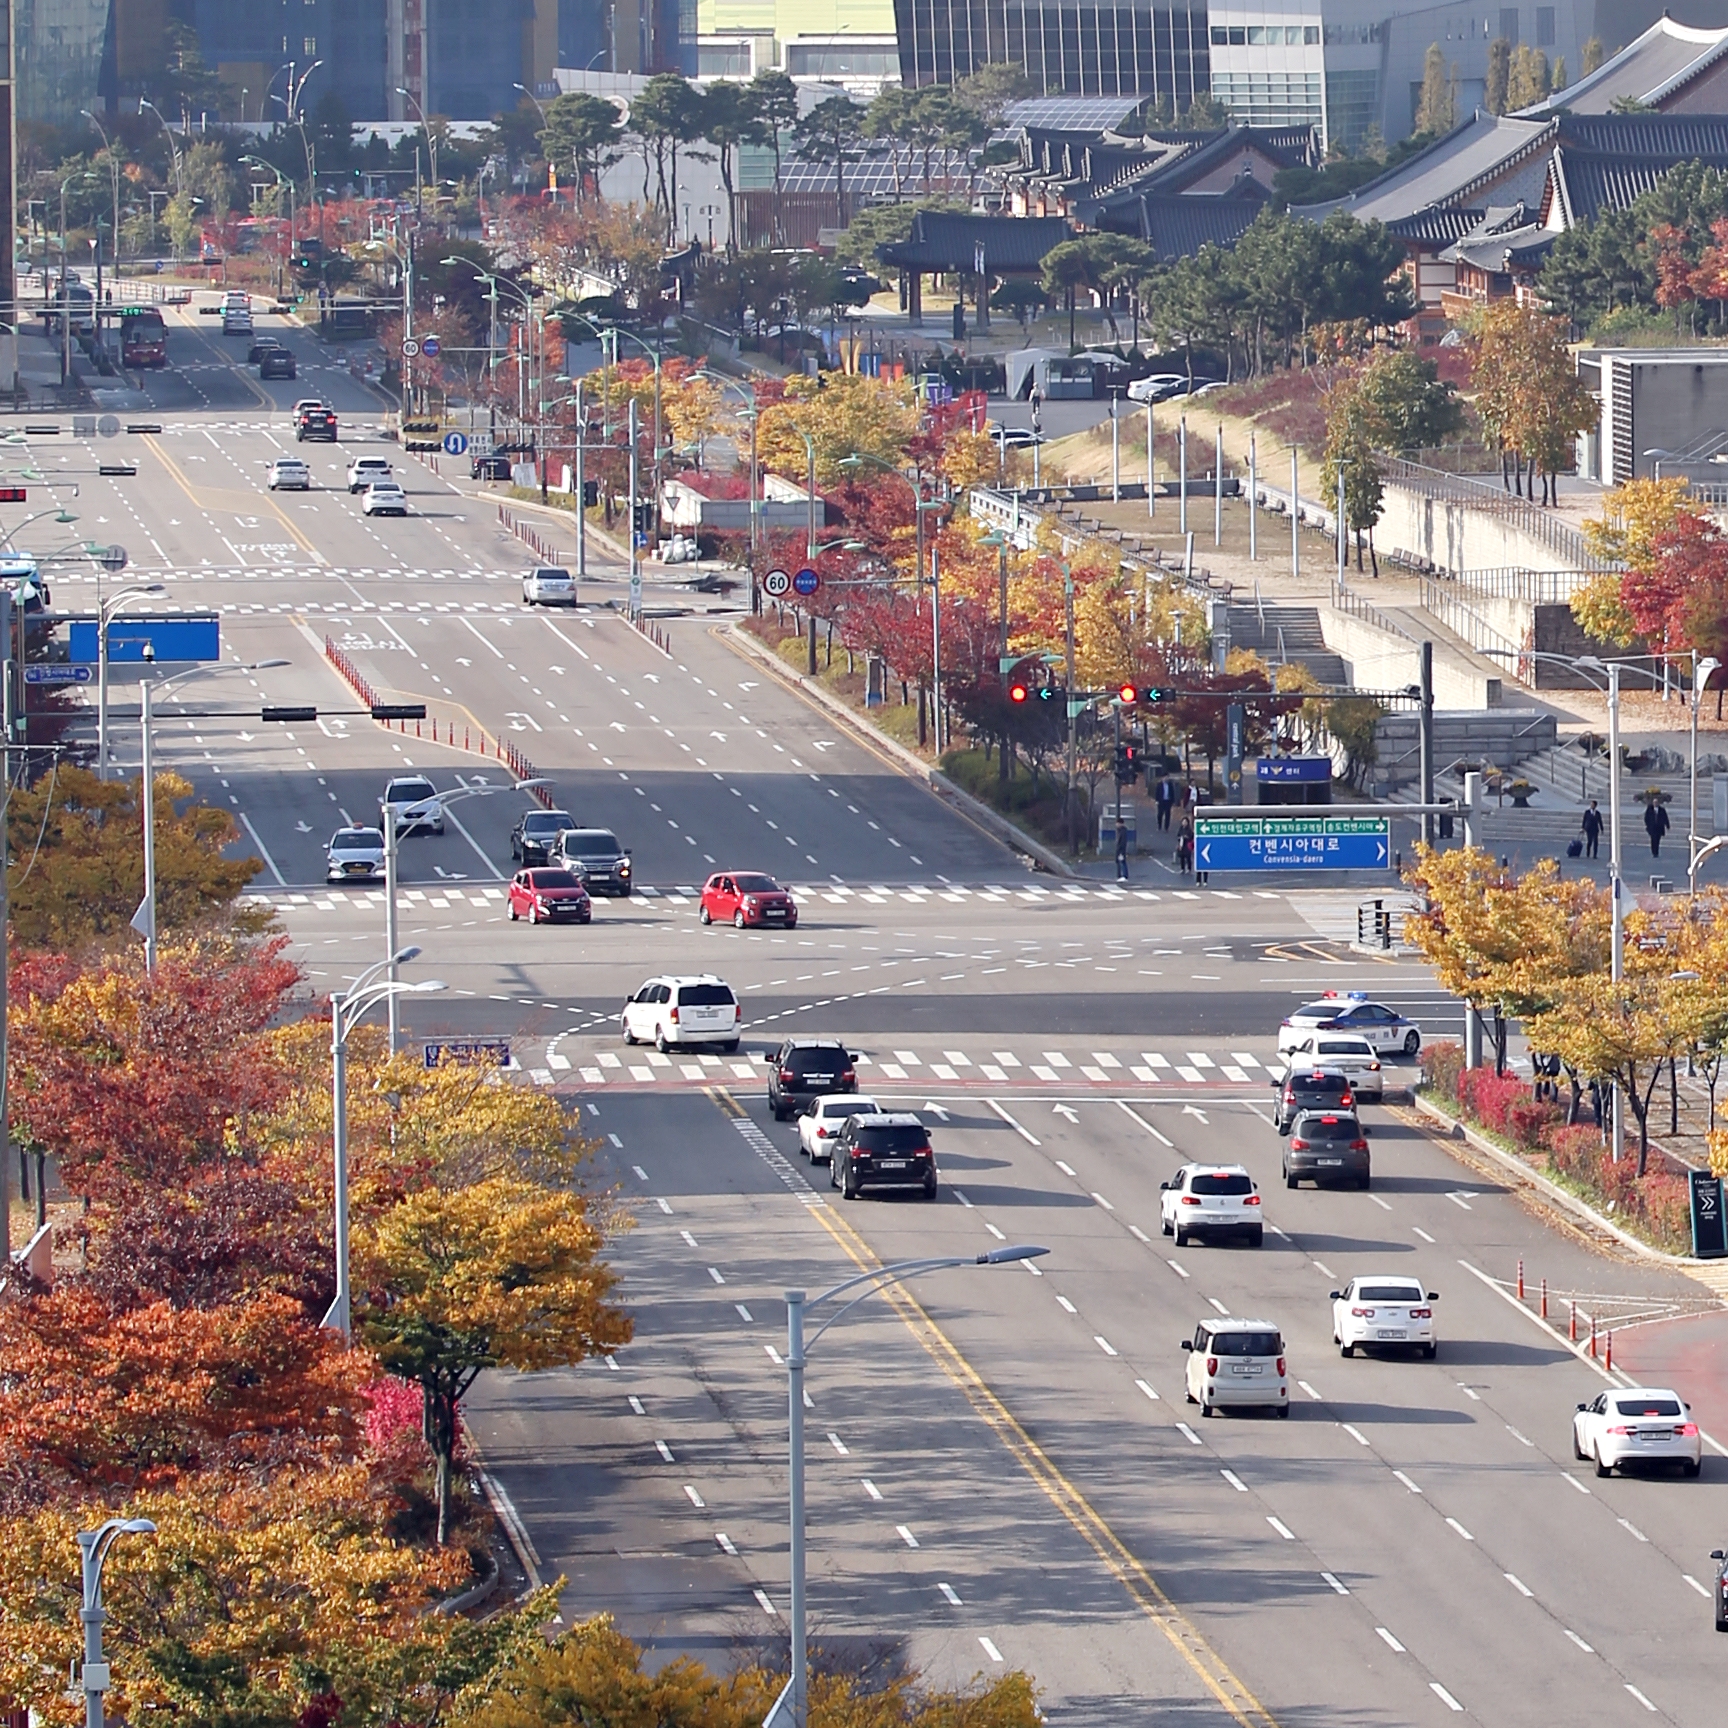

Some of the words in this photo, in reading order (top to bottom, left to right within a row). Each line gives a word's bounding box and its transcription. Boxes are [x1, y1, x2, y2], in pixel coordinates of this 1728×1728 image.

[405, 343, 417, 353] 60
[769, 576, 785, 590] 60
[1326, 821, 1374, 832] 송도컨벤시아
[1248, 837, 1341, 855] 컨벤시아대로
[1263, 854, 1324, 864] Convensia-daero
